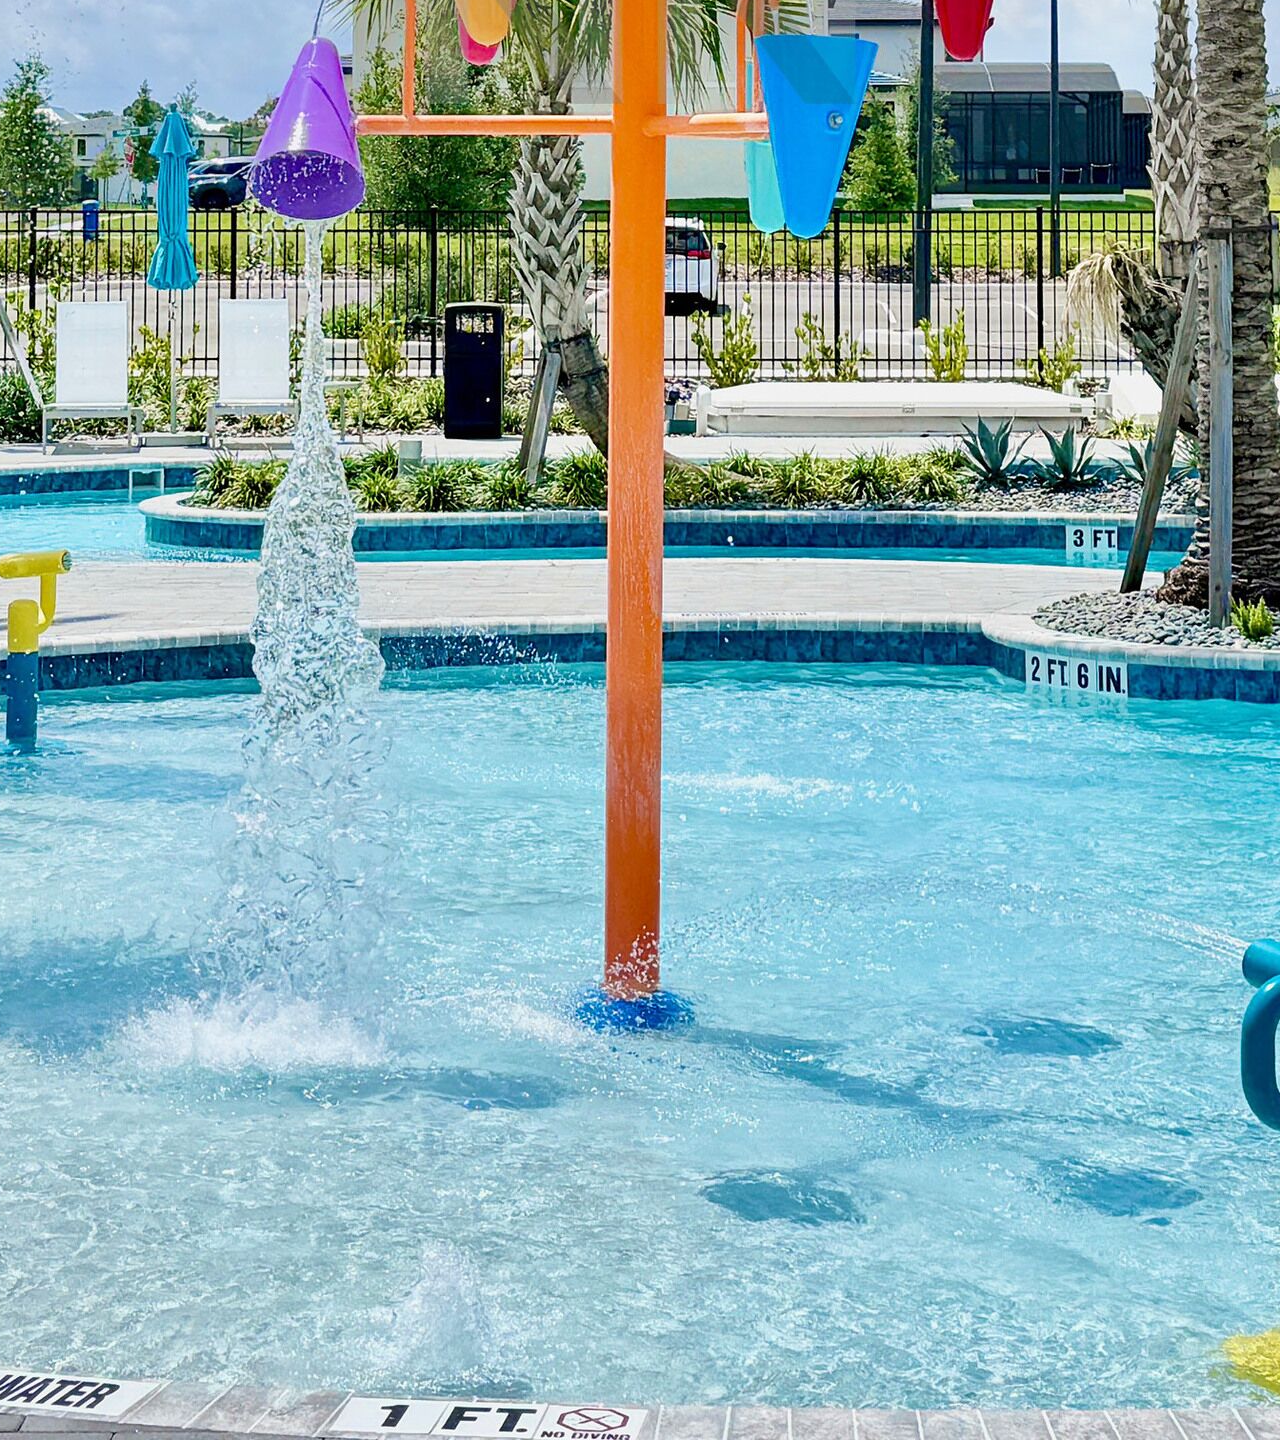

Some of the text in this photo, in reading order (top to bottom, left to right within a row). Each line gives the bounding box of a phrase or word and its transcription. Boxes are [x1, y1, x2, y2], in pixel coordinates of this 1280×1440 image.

[1073, 529, 1116, 548] 3 FT.
[1031, 656, 1126, 694] 2 FT. 6 IN.
[380, 1404, 536, 1433] 1 FT.
[541, 1430, 631, 1440] NO DIVING
